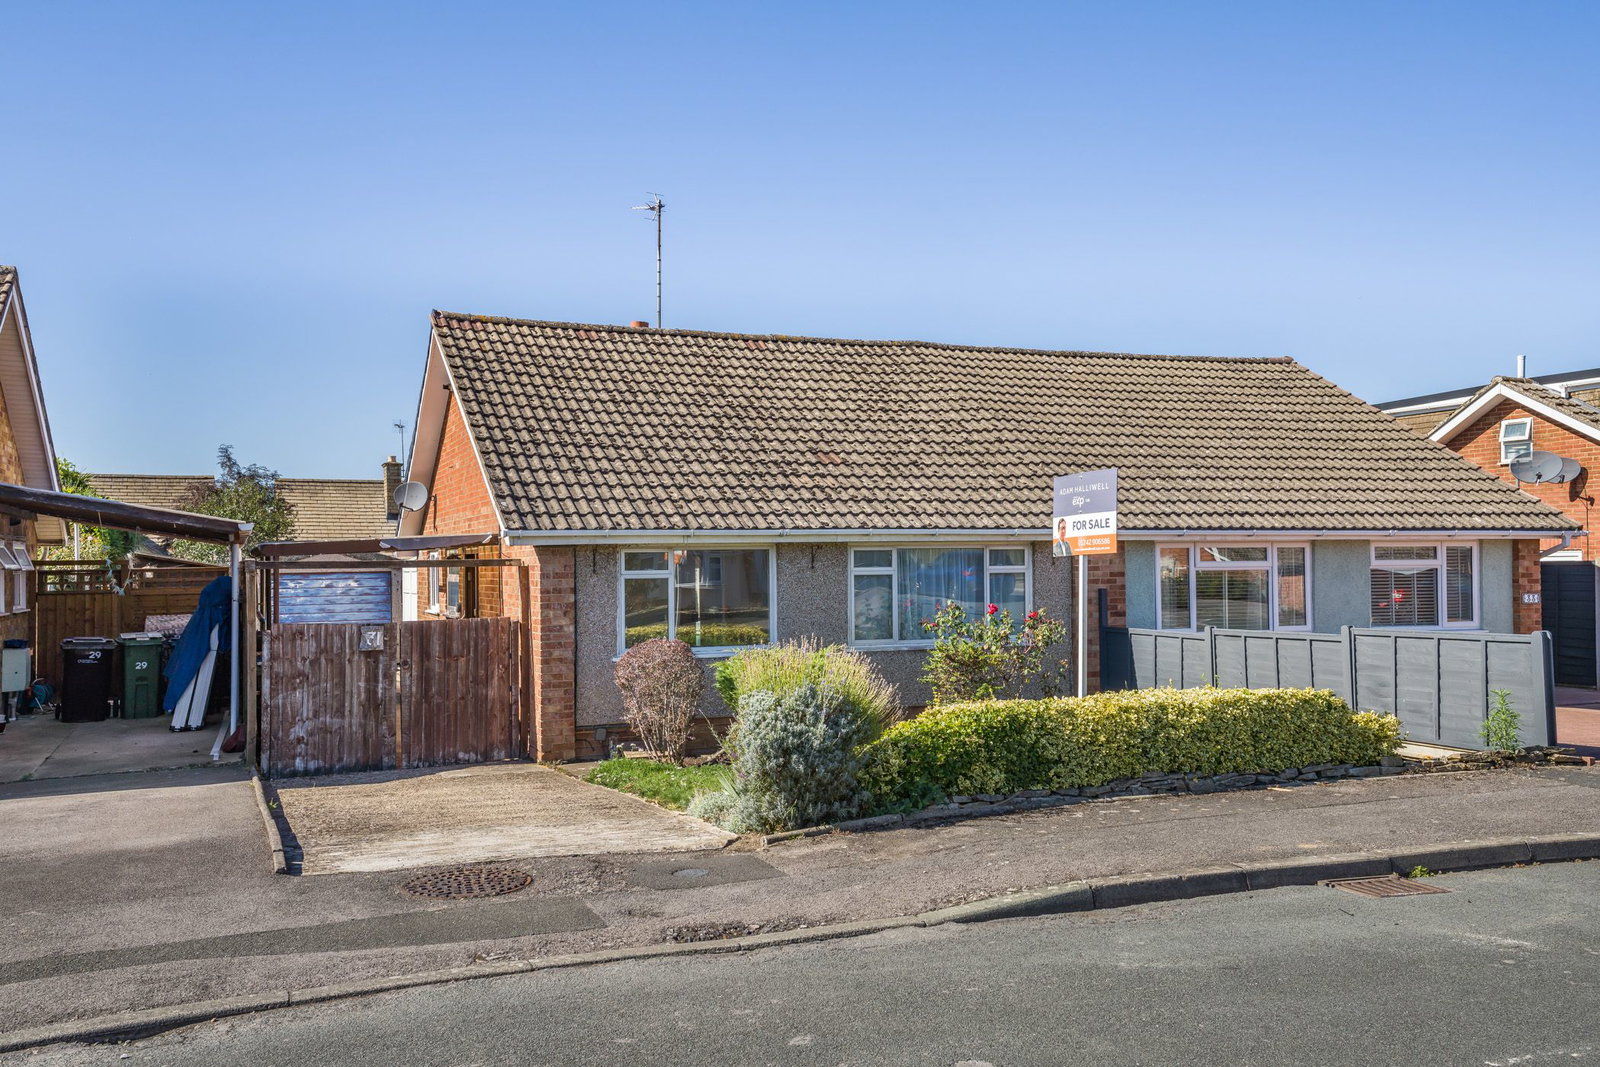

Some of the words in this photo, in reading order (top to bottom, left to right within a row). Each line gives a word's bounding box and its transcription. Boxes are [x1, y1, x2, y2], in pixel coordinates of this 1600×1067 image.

[1060, 487, 1073, 495] ADAM
[1074, 482, 1109, 493] HALLIWELL
[1072, 520, 1087, 531] FOR
[1088, 518, 1110, 530] SALE
[88, 651, 102, 659] 29
[135, 662, 148, 670] 29
